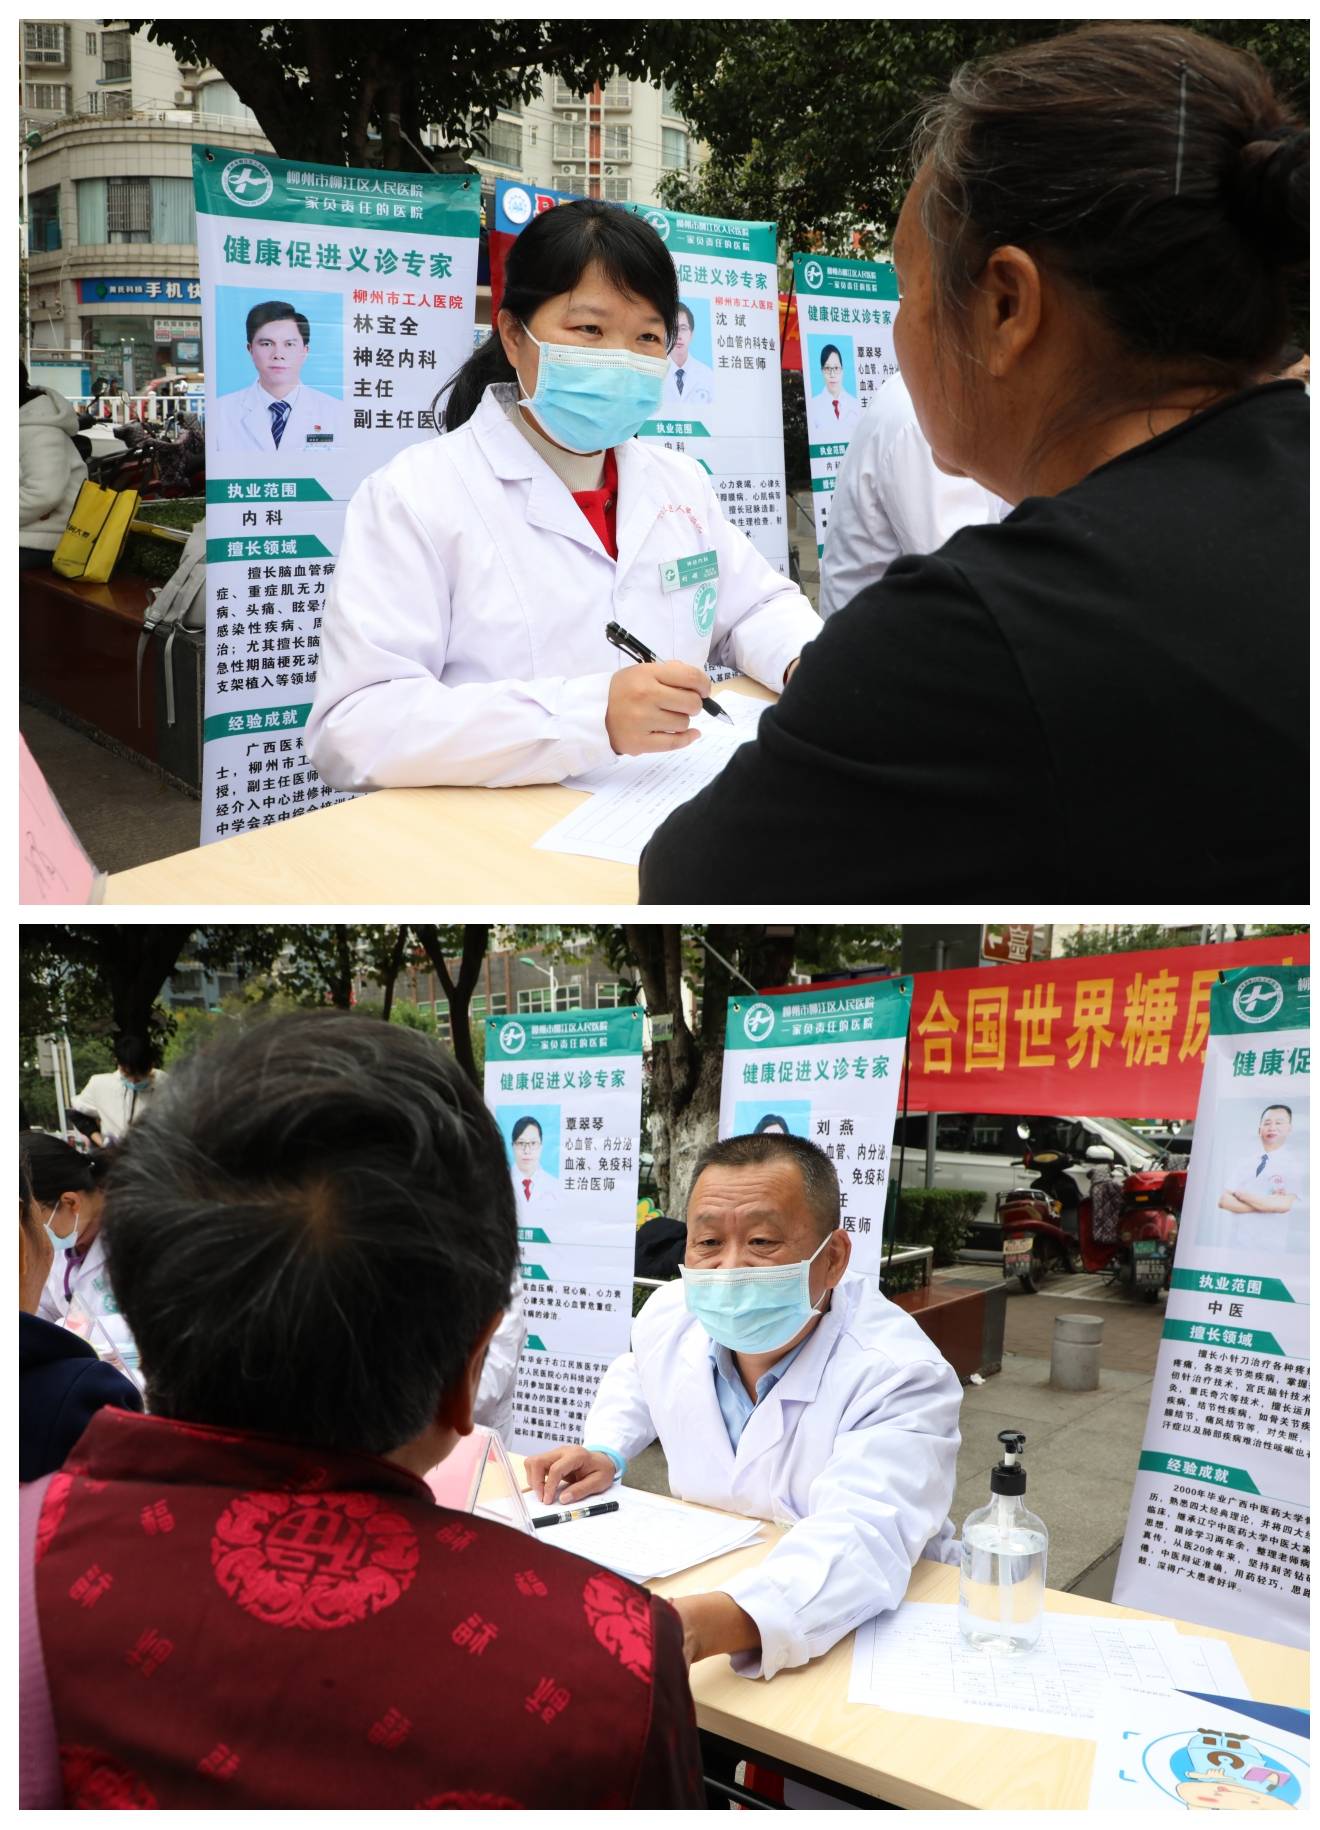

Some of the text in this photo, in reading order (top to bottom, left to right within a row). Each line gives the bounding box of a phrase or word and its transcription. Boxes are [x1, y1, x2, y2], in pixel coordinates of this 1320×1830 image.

[286, 169, 424, 198] 柳州市柳江区人民医院
[223, 234, 453, 279] 健康促进义诊专家
[352, 288, 463, 310] 柳州市工人医院
[715, 296, 774, 311] 柳州市工人医院
[353, 313, 419, 336] 林宝全
[808, 304, 892, 325] 健康促进义诊专家
[717, 335, 776, 351] 心血管内科专业
[353, 347, 437, 370] 神经内科
[718, 355, 766, 370] 主治医师
[353, 378, 394, 399] 主任
[656, 422, 692, 434] 执业范围
[227, 482, 297, 499] 执业范围
[242, 509, 283, 526] 内科
[227, 540, 297, 557] 擅长领域
[228, 709, 298, 731] 经验成就
[500, 1069, 625, 1091] 健康促进义诊专家
[743, 1055, 889, 1084] 健康促进义诊专家
[816, 1119, 854, 1136] 刘燕
[565, 1137, 632, 1151] 心血管、内分泌
[564, 1157, 632, 1171] 血液、免疫科
[564, 1177, 615, 1192] 主治医师
[1199, 1274, 1262, 1295] 执业范围
[1207, 1300, 1245, 1318] 中医
[1189, 1325, 1253, 1347] 擅长领域
[1198, 1349, 1310, 1376] 擅长小针刀治疗各种疼
[1166, 1458, 1229, 1483] 经验成就
